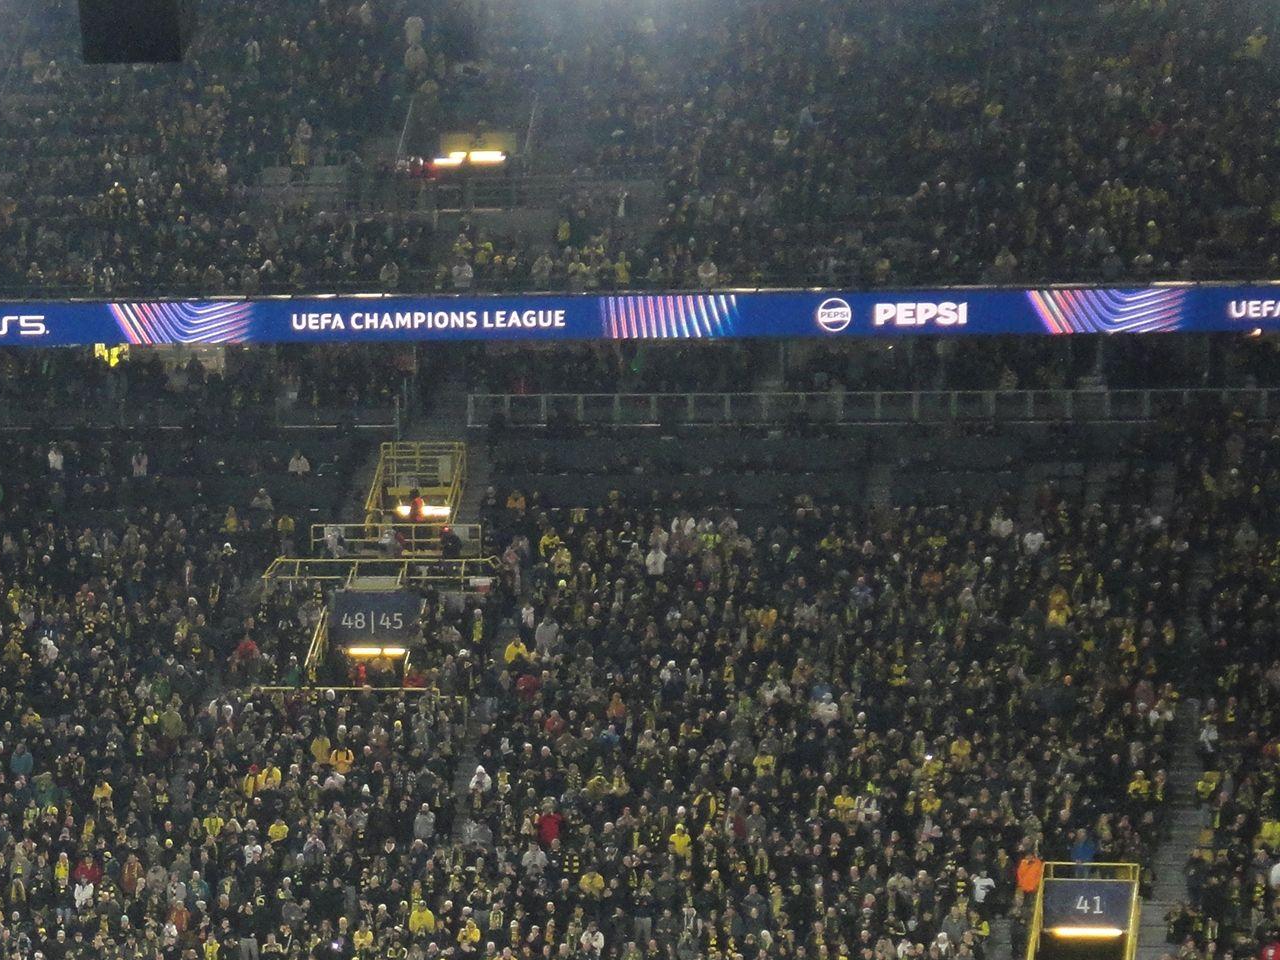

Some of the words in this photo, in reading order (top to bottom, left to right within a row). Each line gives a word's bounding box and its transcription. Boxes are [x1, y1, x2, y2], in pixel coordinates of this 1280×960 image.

[292, 313, 345, 330] UEFA
[350, 311, 478, 329] CHAMPIONS
[483, 310, 566, 328] LEAGUE
[875, 302, 968, 325] PEPSI
[1076, 895, 1103, 914] 41
